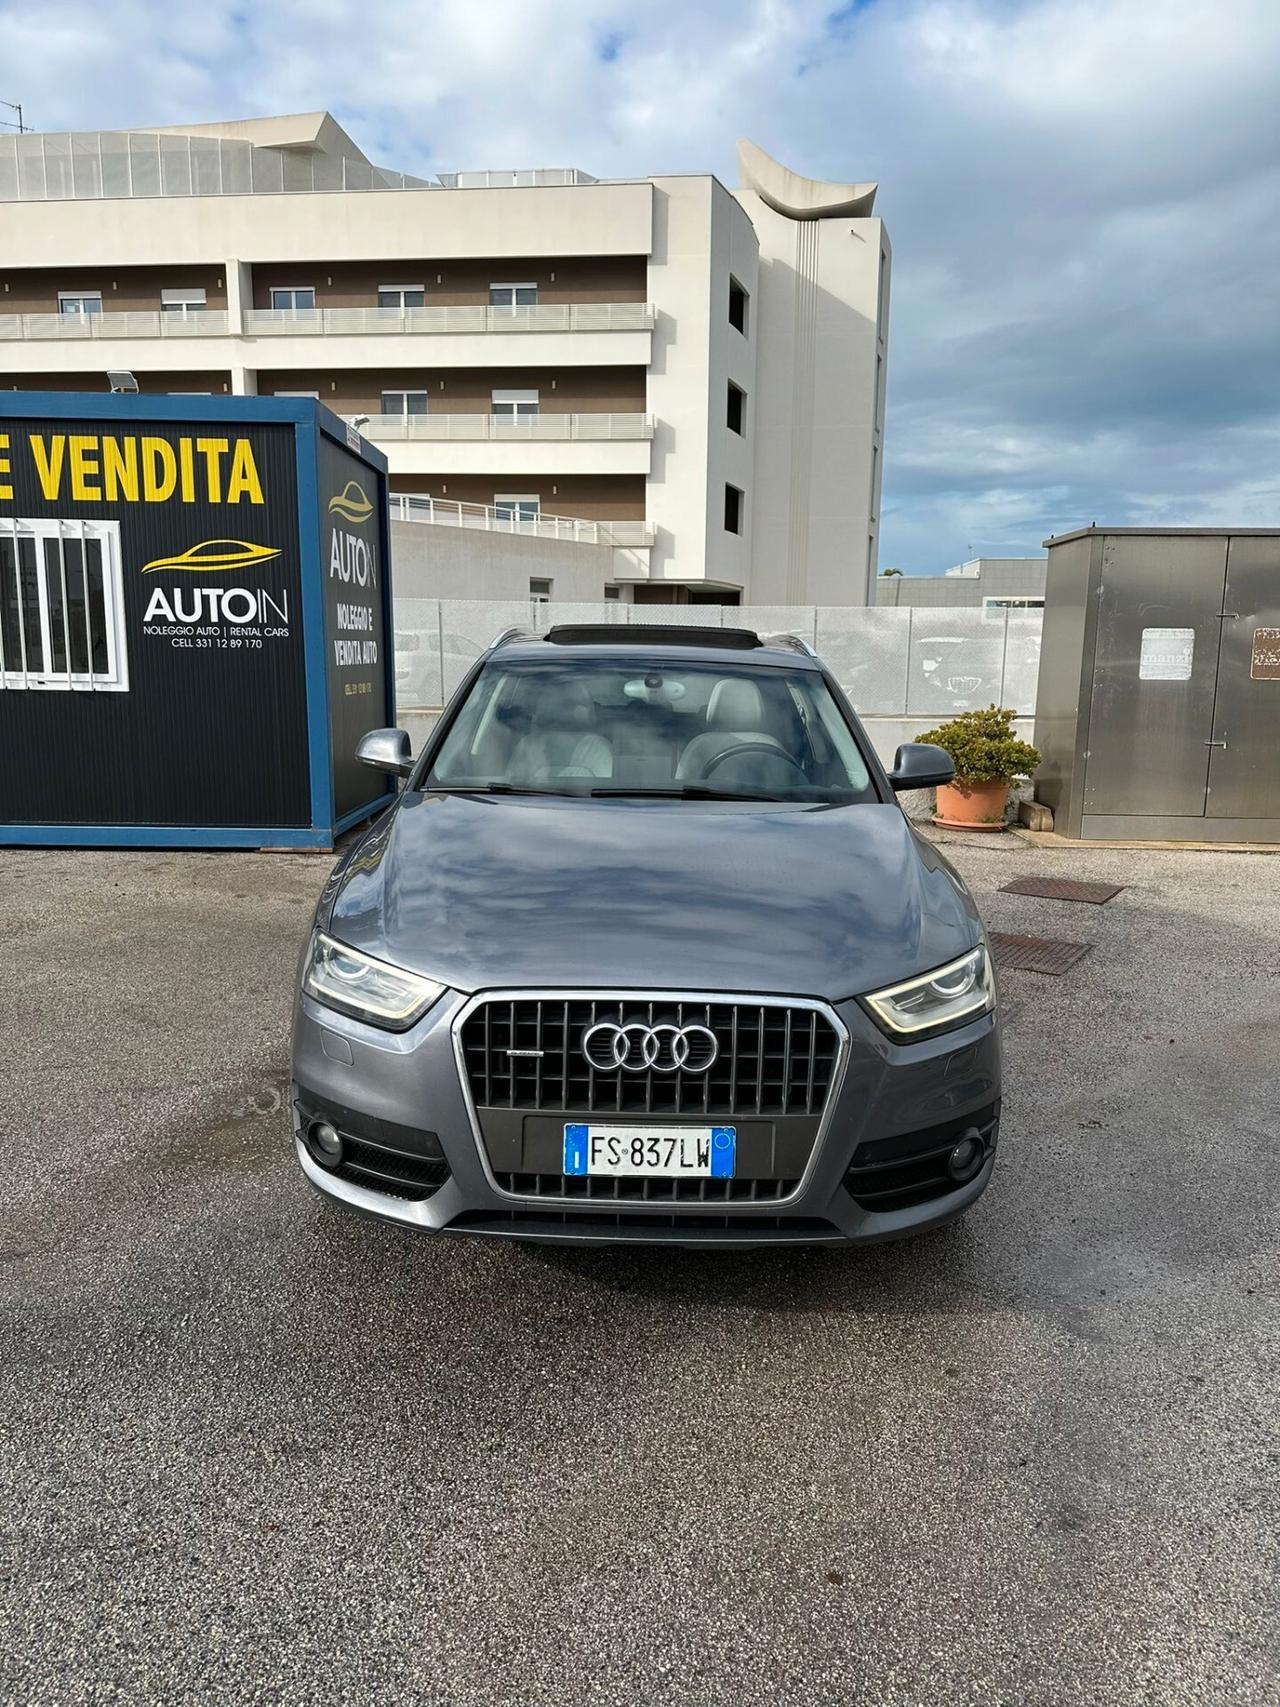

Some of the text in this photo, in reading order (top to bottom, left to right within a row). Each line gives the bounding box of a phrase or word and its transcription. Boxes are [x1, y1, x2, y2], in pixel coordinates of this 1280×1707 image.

[29, 434, 265, 505] VENDITA
[143, 587, 289, 624] AUTOIN
[336, 603, 373, 632] NOLEGGIO E
[143, 625, 289, 637] NOLEGGIO AUTO RENTAL CARS
[171, 638, 263, 649] CELL 331 12 89 170
[334, 640, 378, 666] VENDITA AUTO
[591, 1136, 621, 1166] FS
